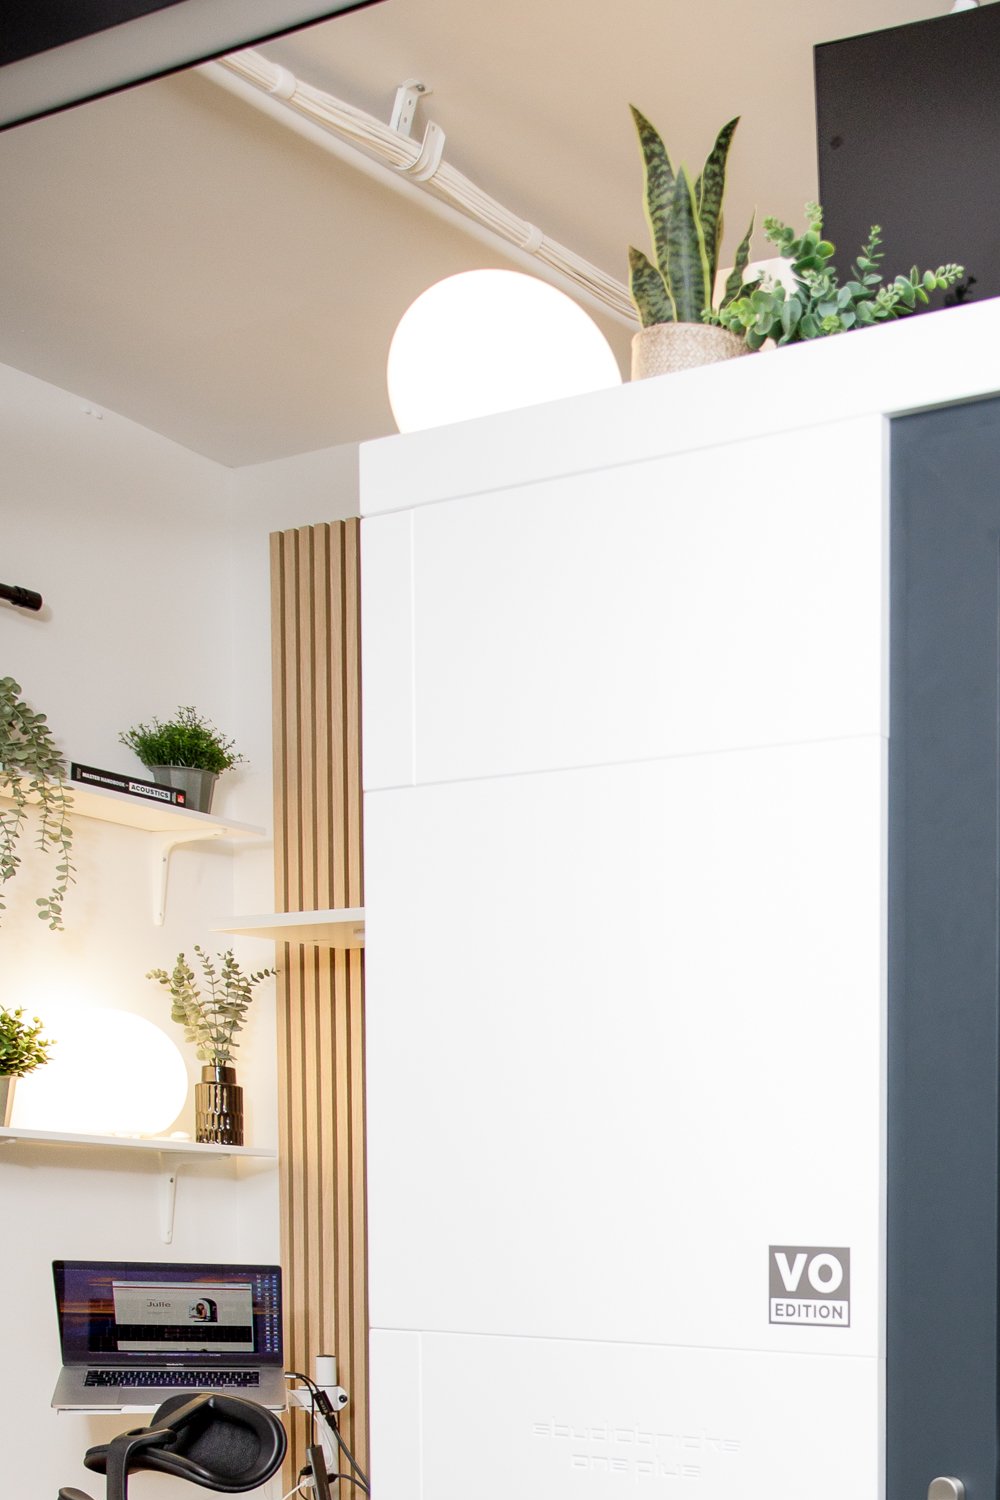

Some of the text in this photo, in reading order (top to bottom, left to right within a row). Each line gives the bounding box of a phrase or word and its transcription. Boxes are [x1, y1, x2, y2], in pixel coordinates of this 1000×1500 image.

[131, 784, 169, 798] ACOUSTICS
[774, 1252, 843, 1294] VO
[775, 1303, 843, 1320] EDITION
[571, 1453, 629, 1473] one
